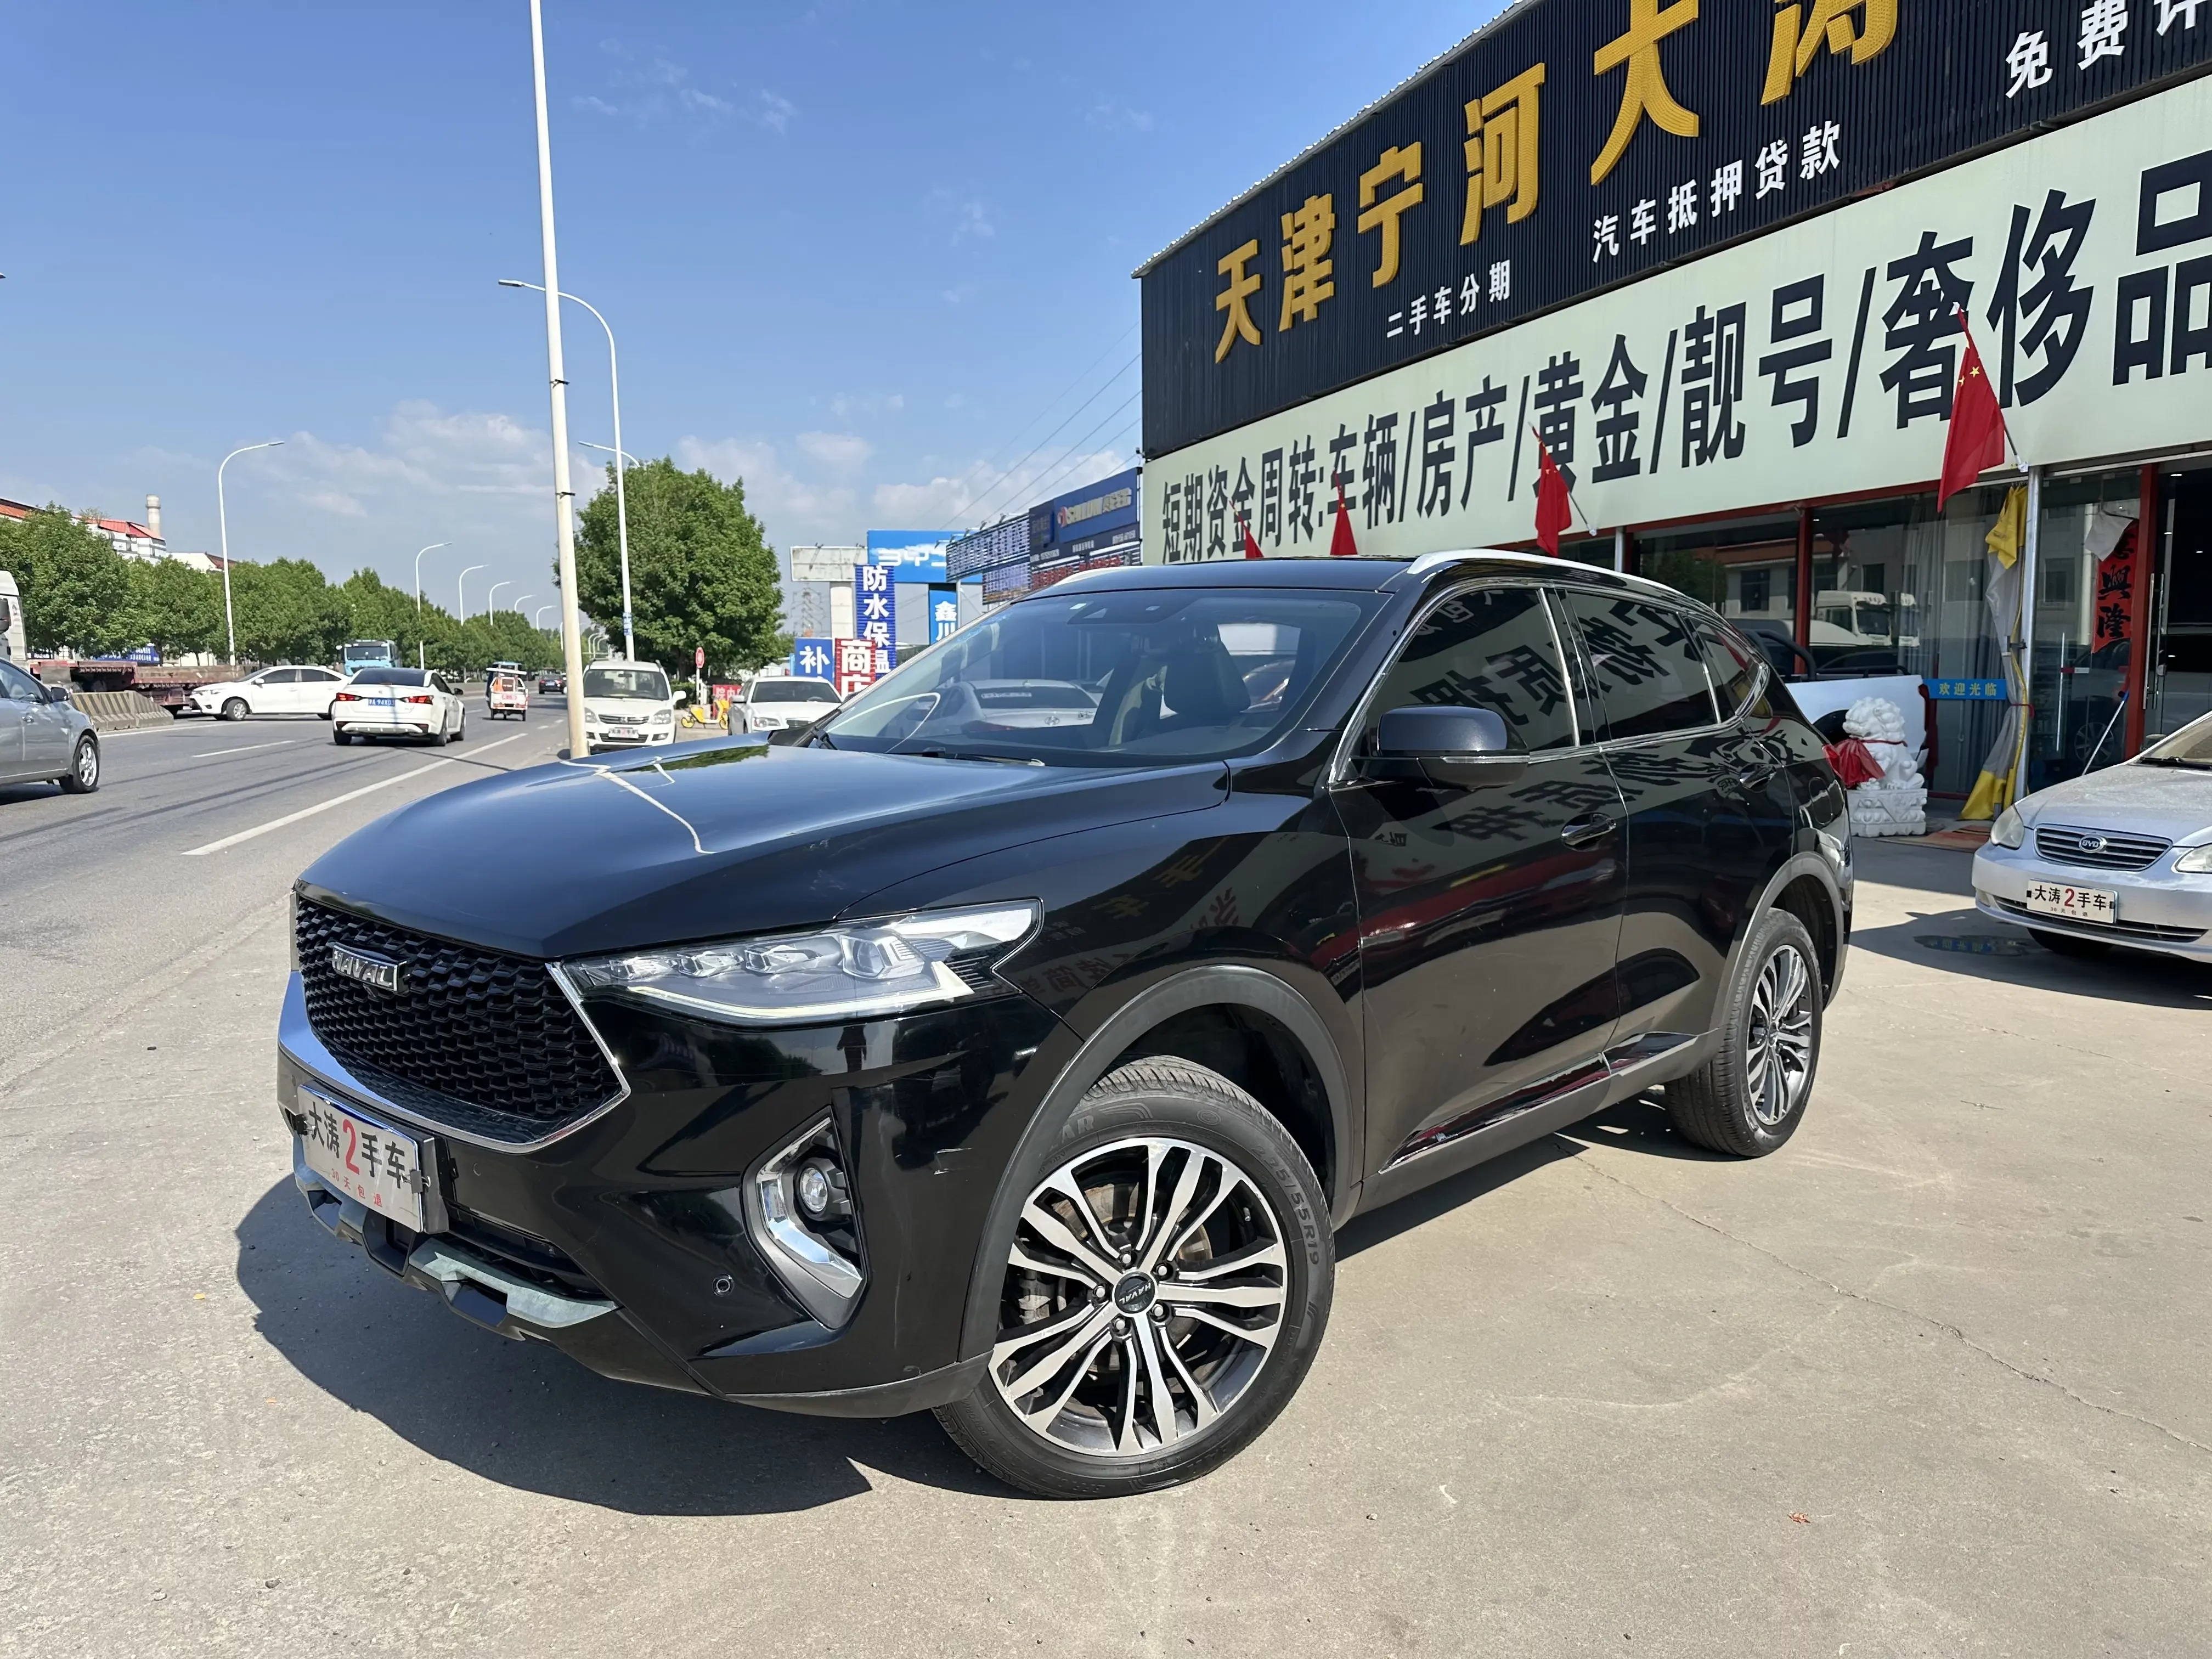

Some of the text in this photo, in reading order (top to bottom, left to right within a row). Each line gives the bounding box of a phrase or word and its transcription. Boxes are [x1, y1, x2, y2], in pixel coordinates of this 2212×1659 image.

[1387, 259, 1510, 338] 二手车分期
[1593, 121, 1841, 263] 汽车抵押贷款
[1939, 682, 1997, 696] 欢迎光临
[2082, 839, 2099, 848] BYD
[2034, 885, 2107, 911] 大涛2手车
[331, 950, 393, 988] HAVAL
[308, 1101, 405, 1189] 大涛2手车
[1119, 1283, 1151, 1304] HAVAL
